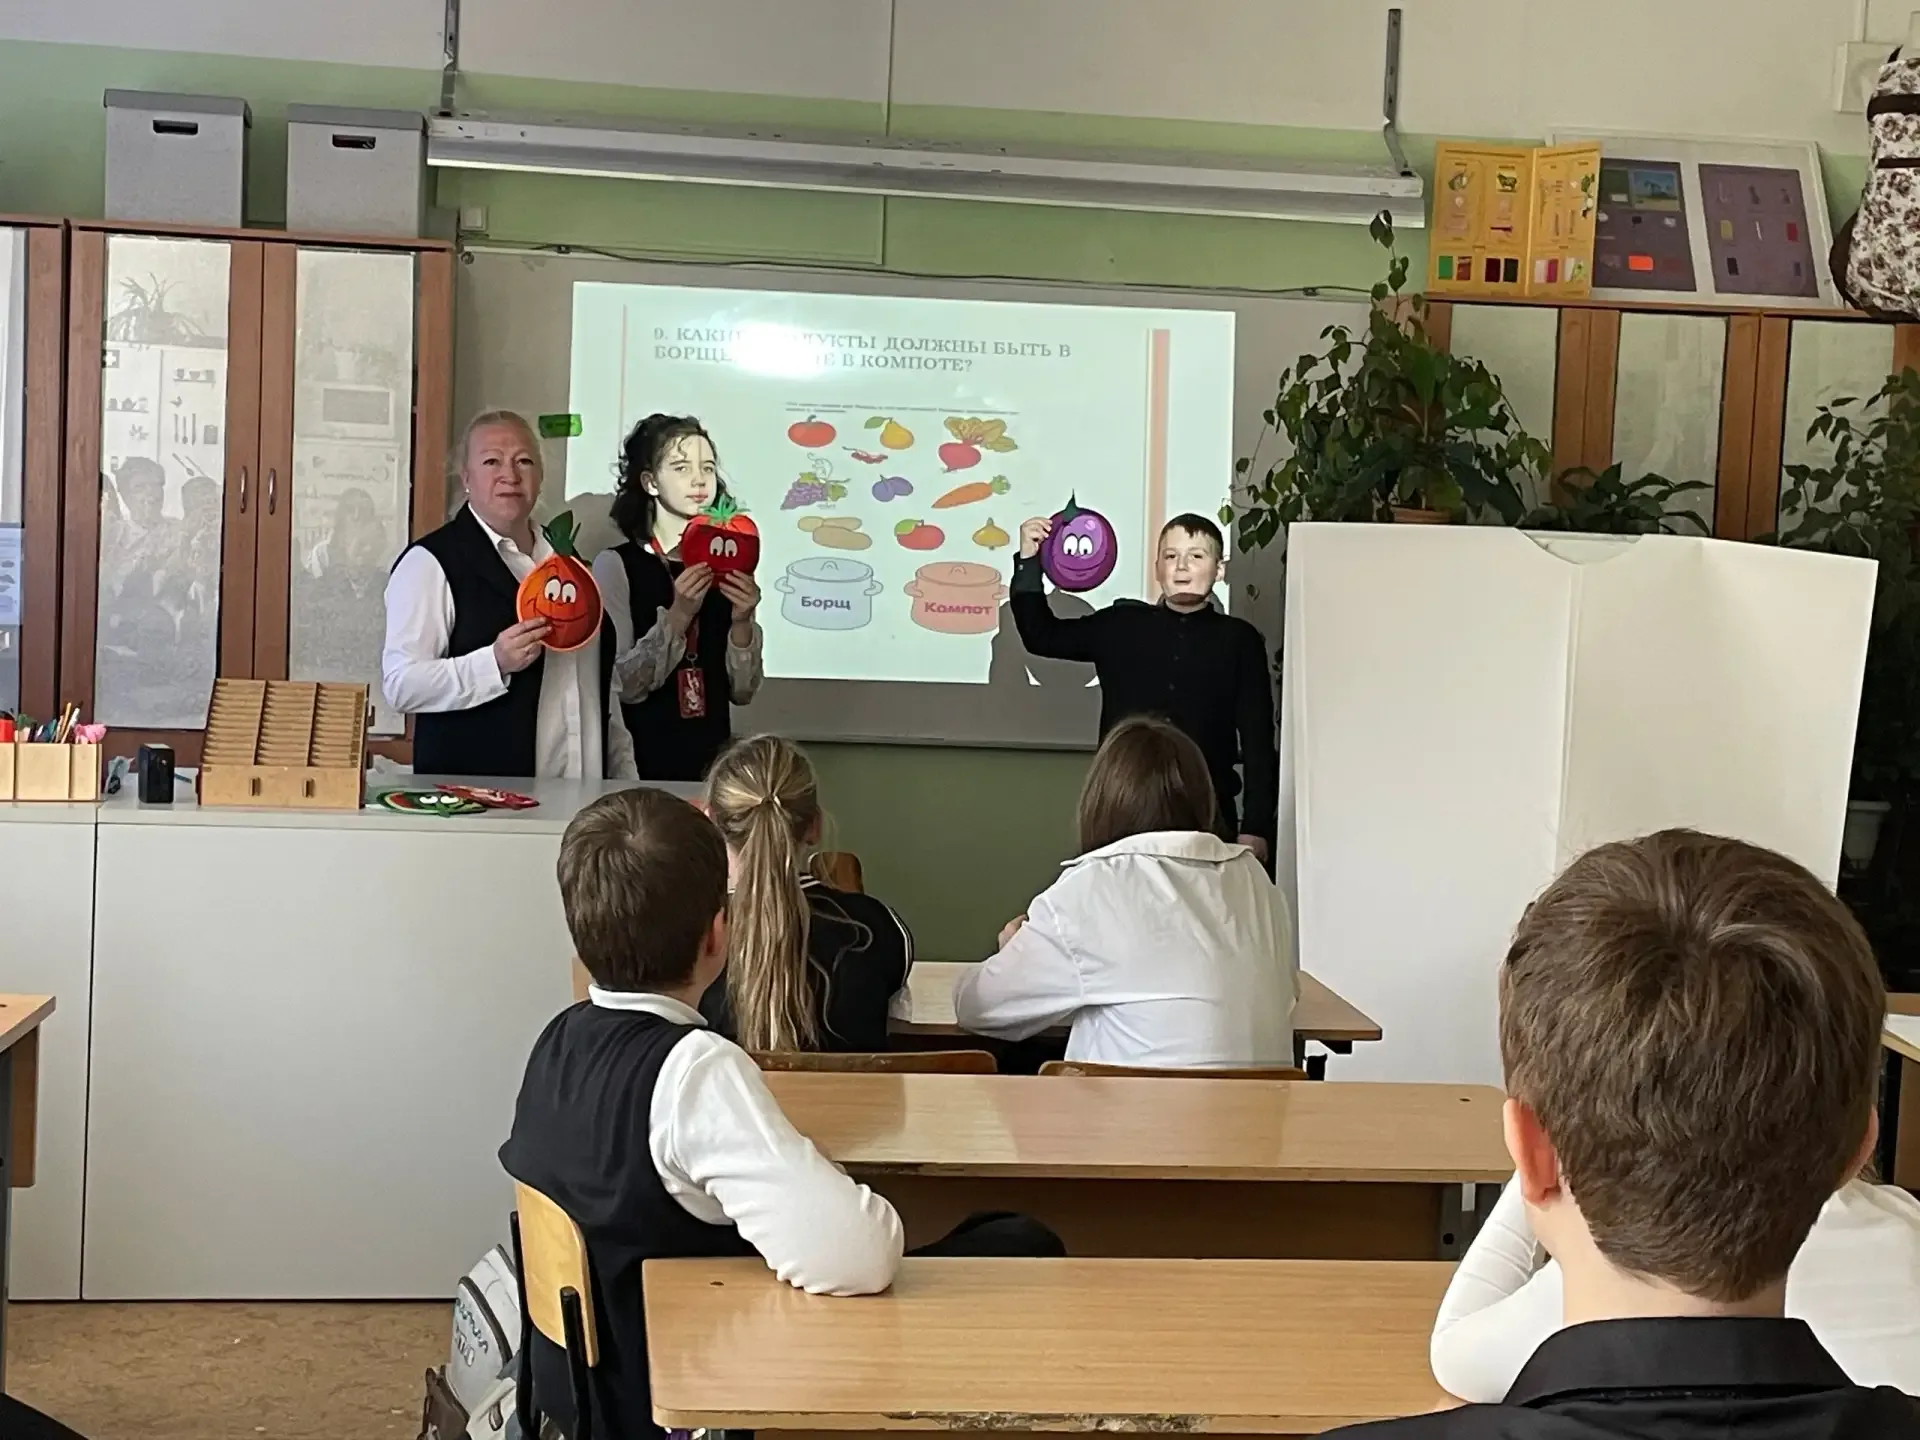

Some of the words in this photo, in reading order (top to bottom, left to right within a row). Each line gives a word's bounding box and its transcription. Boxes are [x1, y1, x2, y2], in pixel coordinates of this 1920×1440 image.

[883, 336, 987, 355] ДОЛЖНЫ
[992, 341, 1051, 357] БЫТЬ
[1059, 344, 1071, 358] В
[843, 353, 855, 367] В
[861, 355, 973, 373] КОМПОТЕ?
[801, 596, 851, 610] Борщ
